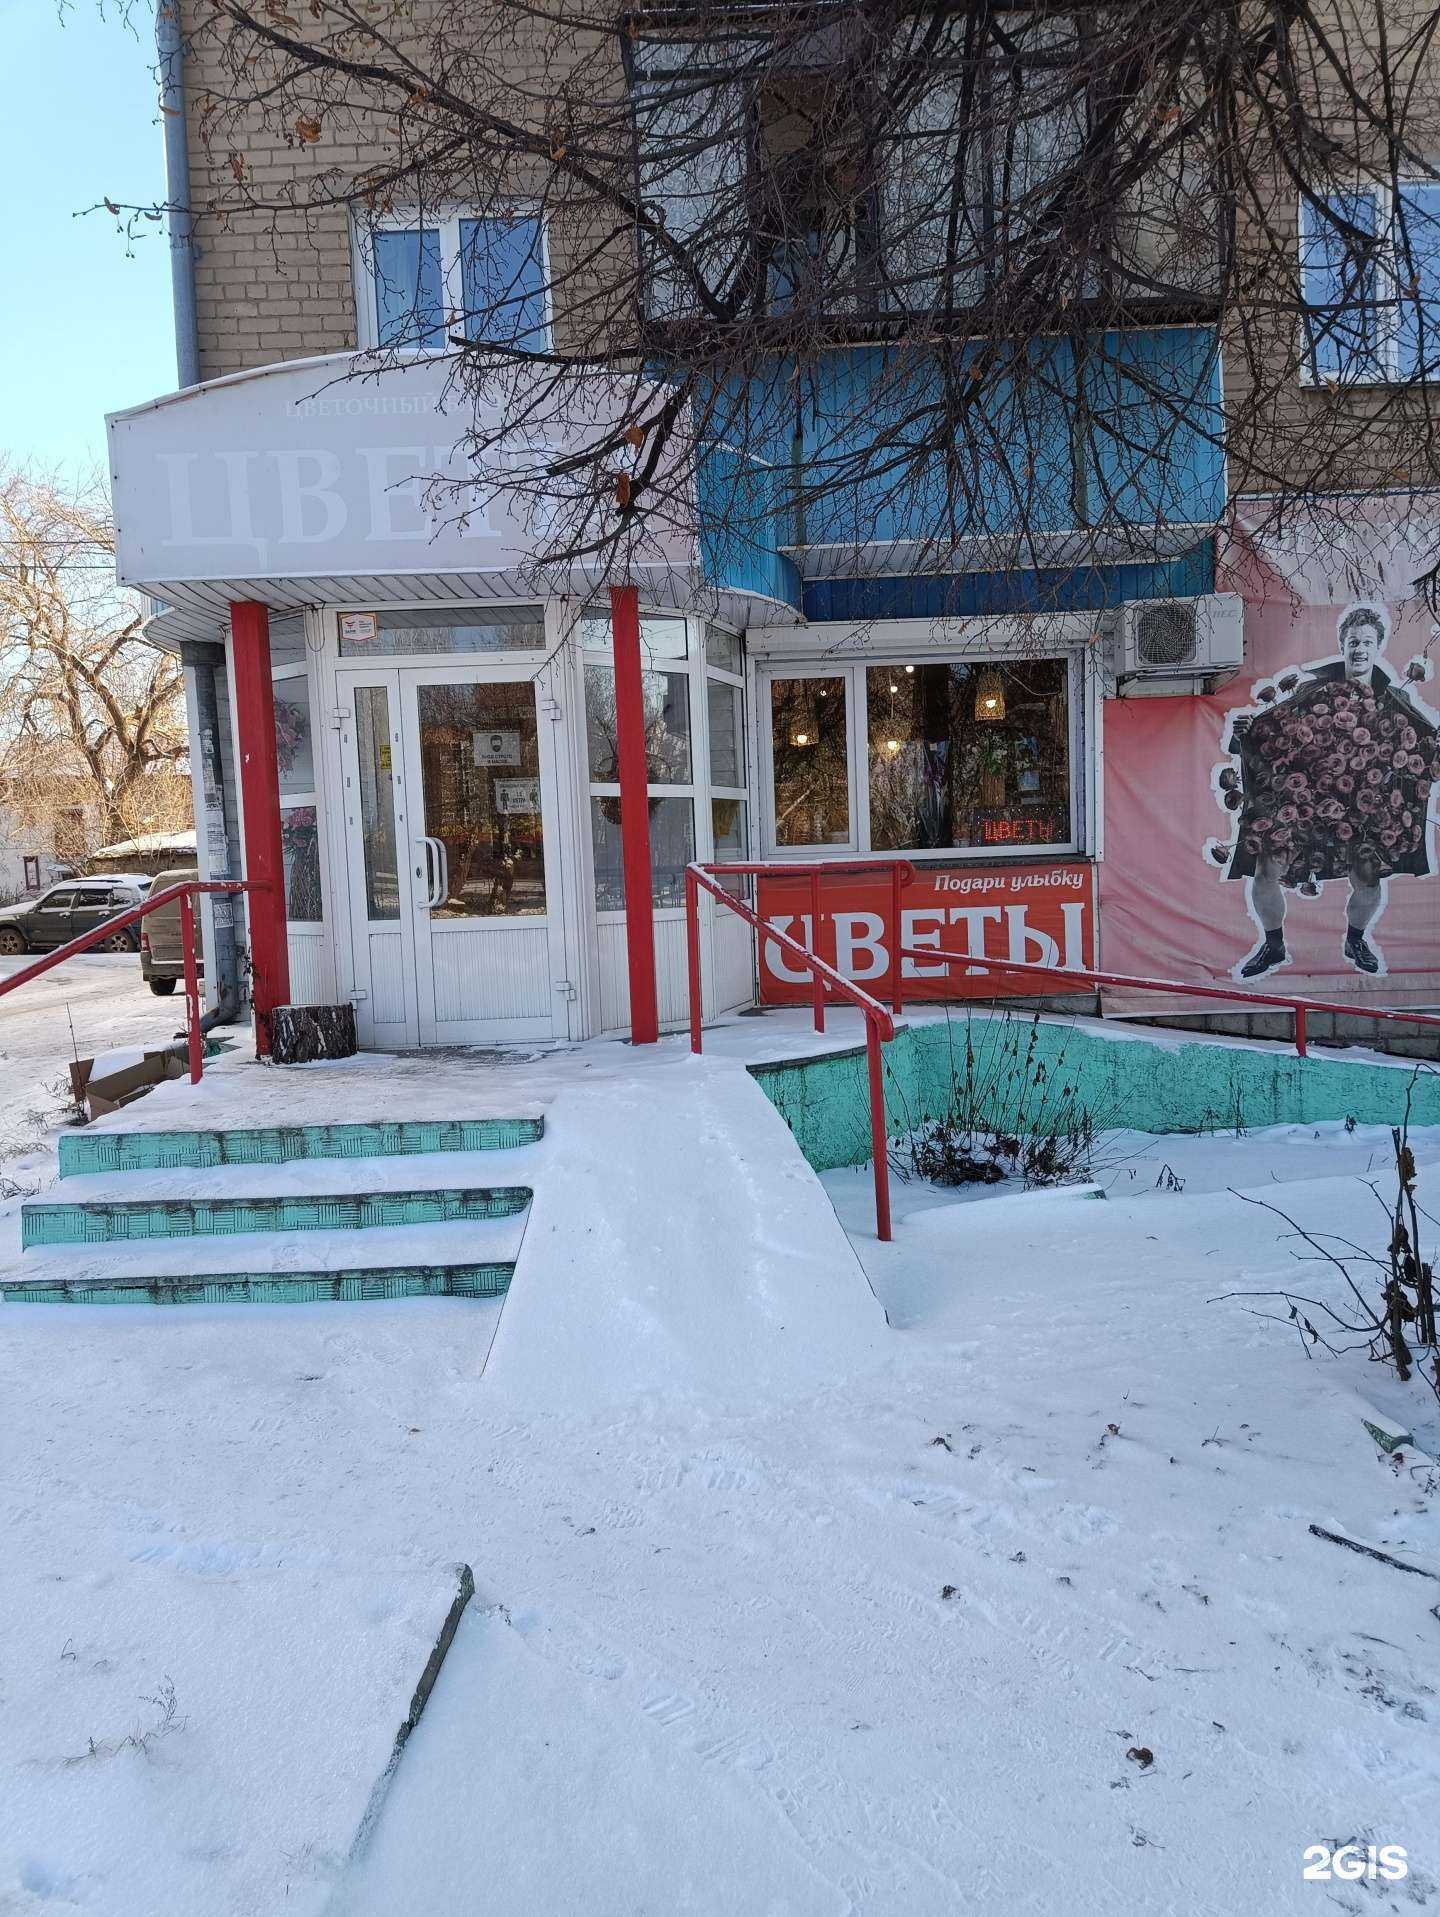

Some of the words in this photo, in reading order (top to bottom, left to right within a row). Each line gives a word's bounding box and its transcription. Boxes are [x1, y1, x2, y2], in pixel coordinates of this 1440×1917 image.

[284, 391, 438, 421] ЦВЕТОЧНЫЙ
[983, 816, 1055, 841] ЦВЕТЫ
[934, 874, 1006, 894] Подари
[1010, 868, 1084, 892] улыбку
[764, 902, 1087, 991] ЦВЕТЫ
